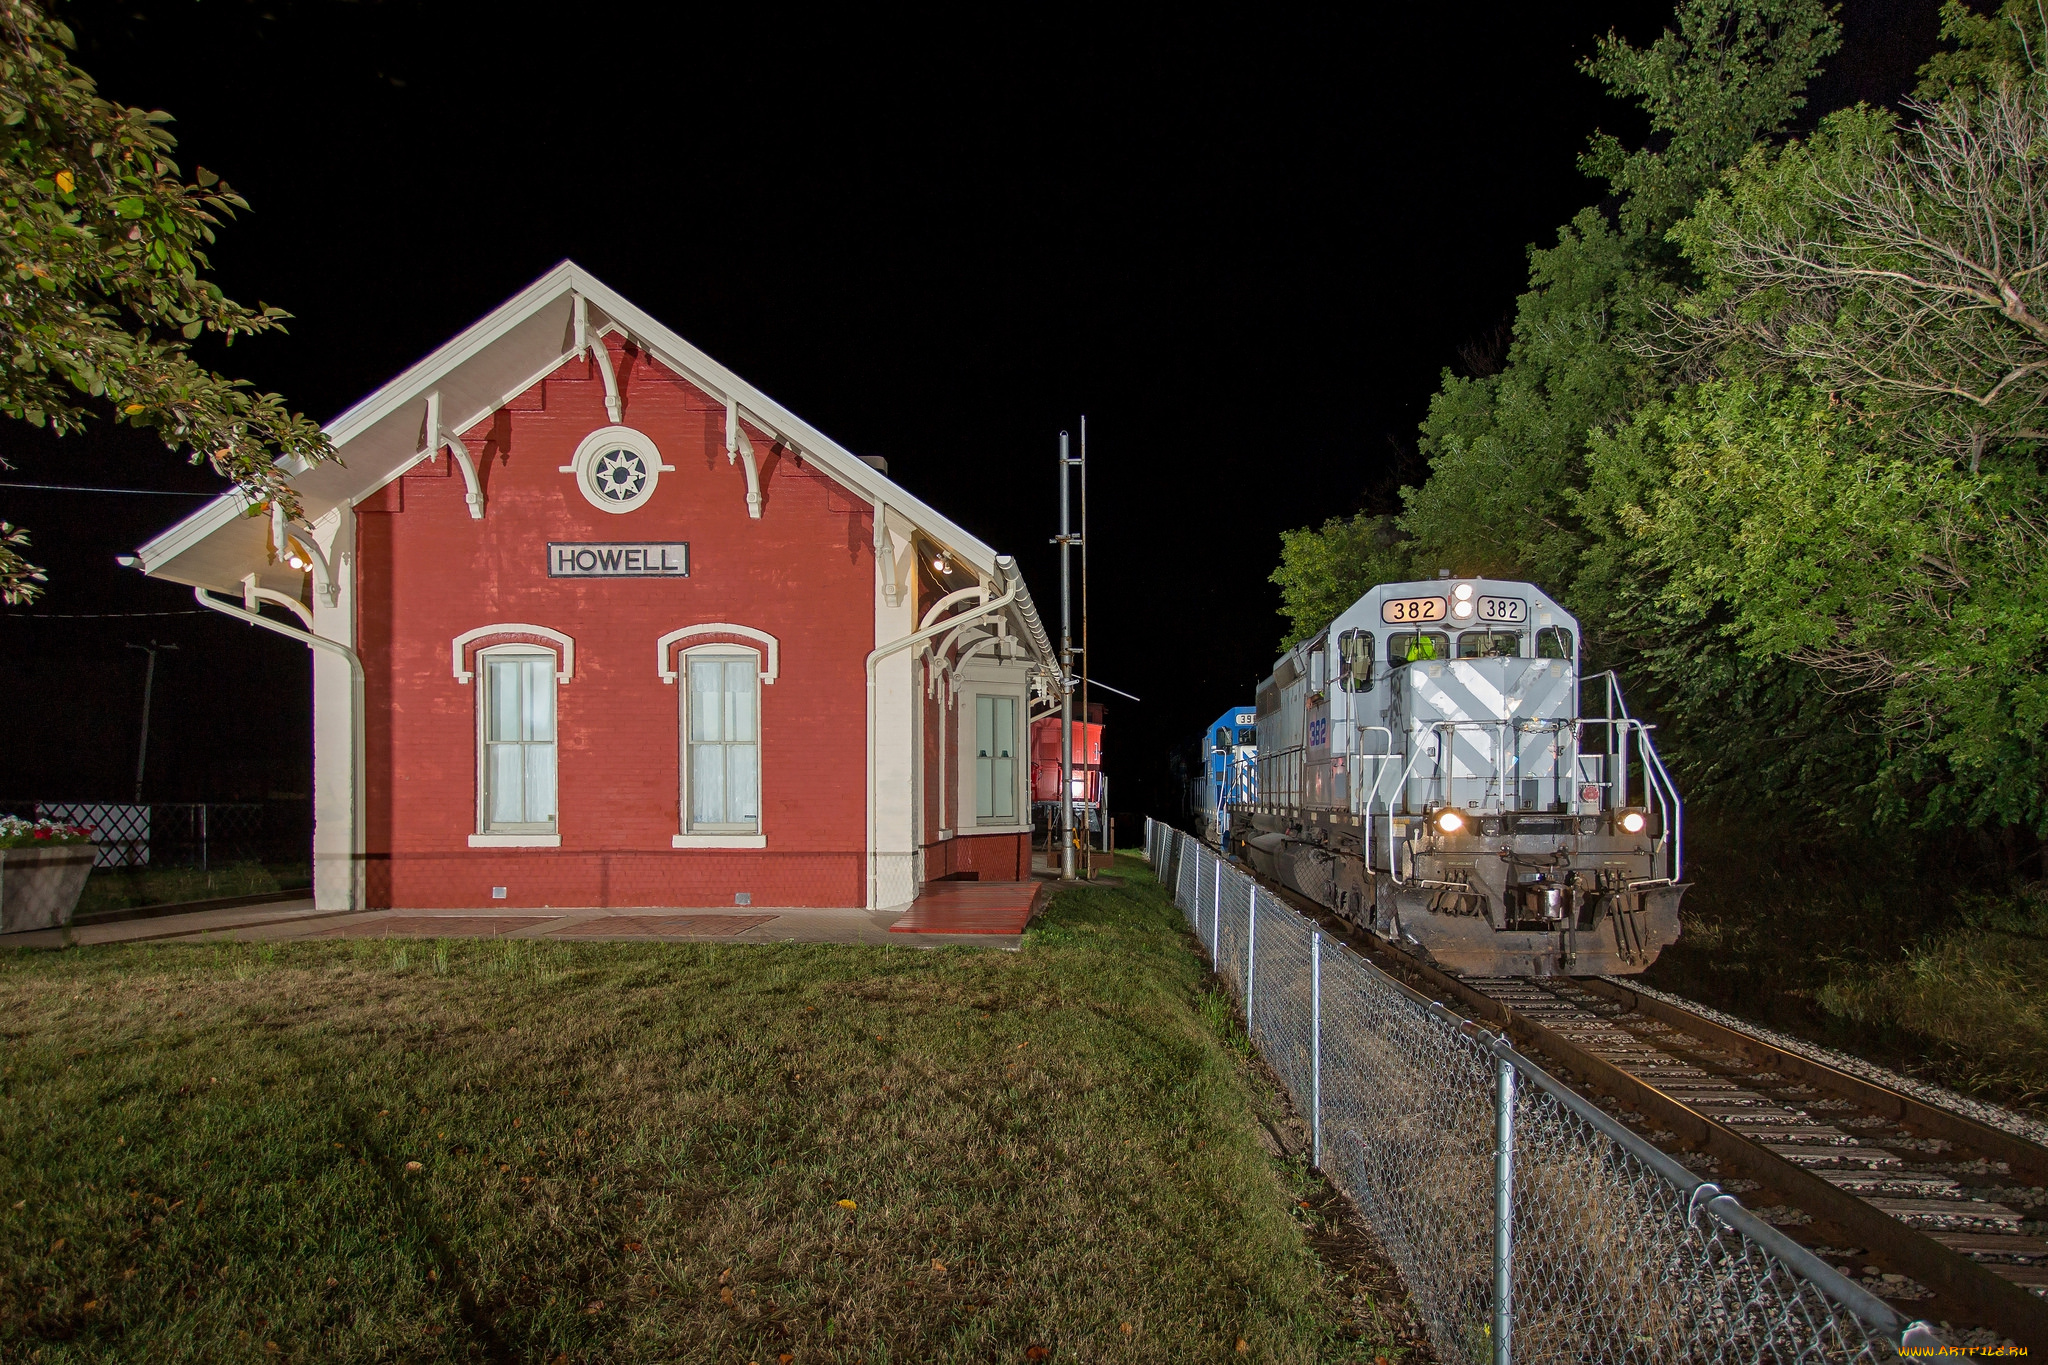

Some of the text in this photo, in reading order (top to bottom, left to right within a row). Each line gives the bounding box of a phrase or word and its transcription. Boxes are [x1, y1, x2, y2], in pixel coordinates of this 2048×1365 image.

[558, 549, 679, 571] HOWELL
[1393, 601, 1435, 620] 382
[1486, 599, 1518, 619] 382
[1309, 717, 1326, 747] 382
